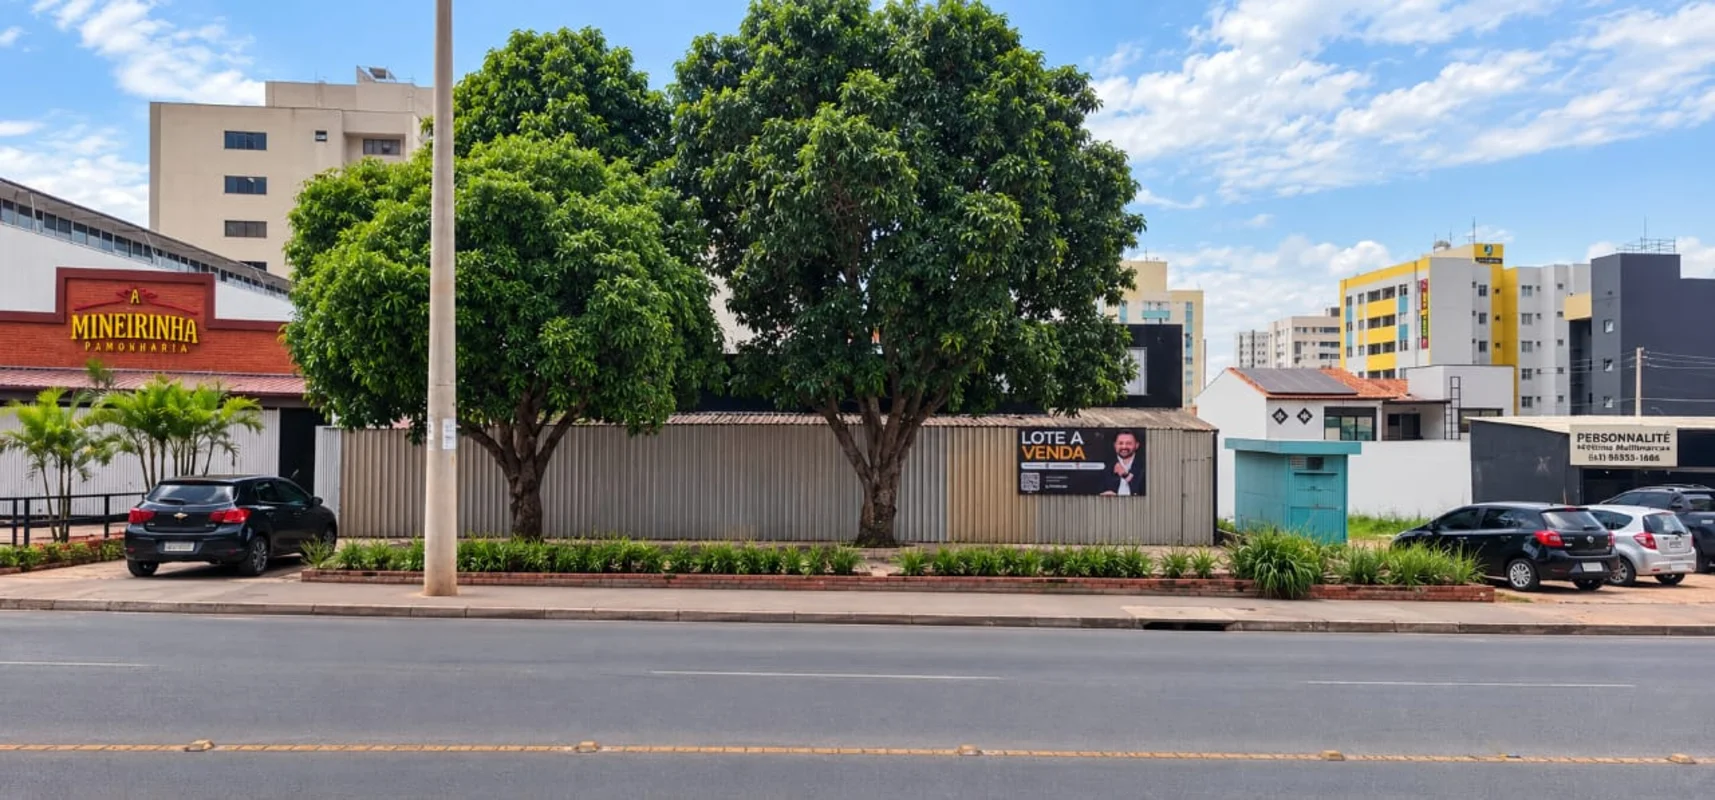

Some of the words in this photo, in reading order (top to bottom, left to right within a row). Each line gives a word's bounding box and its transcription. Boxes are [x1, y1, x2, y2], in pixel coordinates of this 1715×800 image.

[130, 288, 140, 304] A
[71, 313, 198, 343] MINEIRINHA
[85, 341, 188, 353] PAMONHARIA
[1021, 431, 1066, 445] LOTE
[1070, 431, 1084, 445] A
[1021, 445, 1086, 460] VENDA
